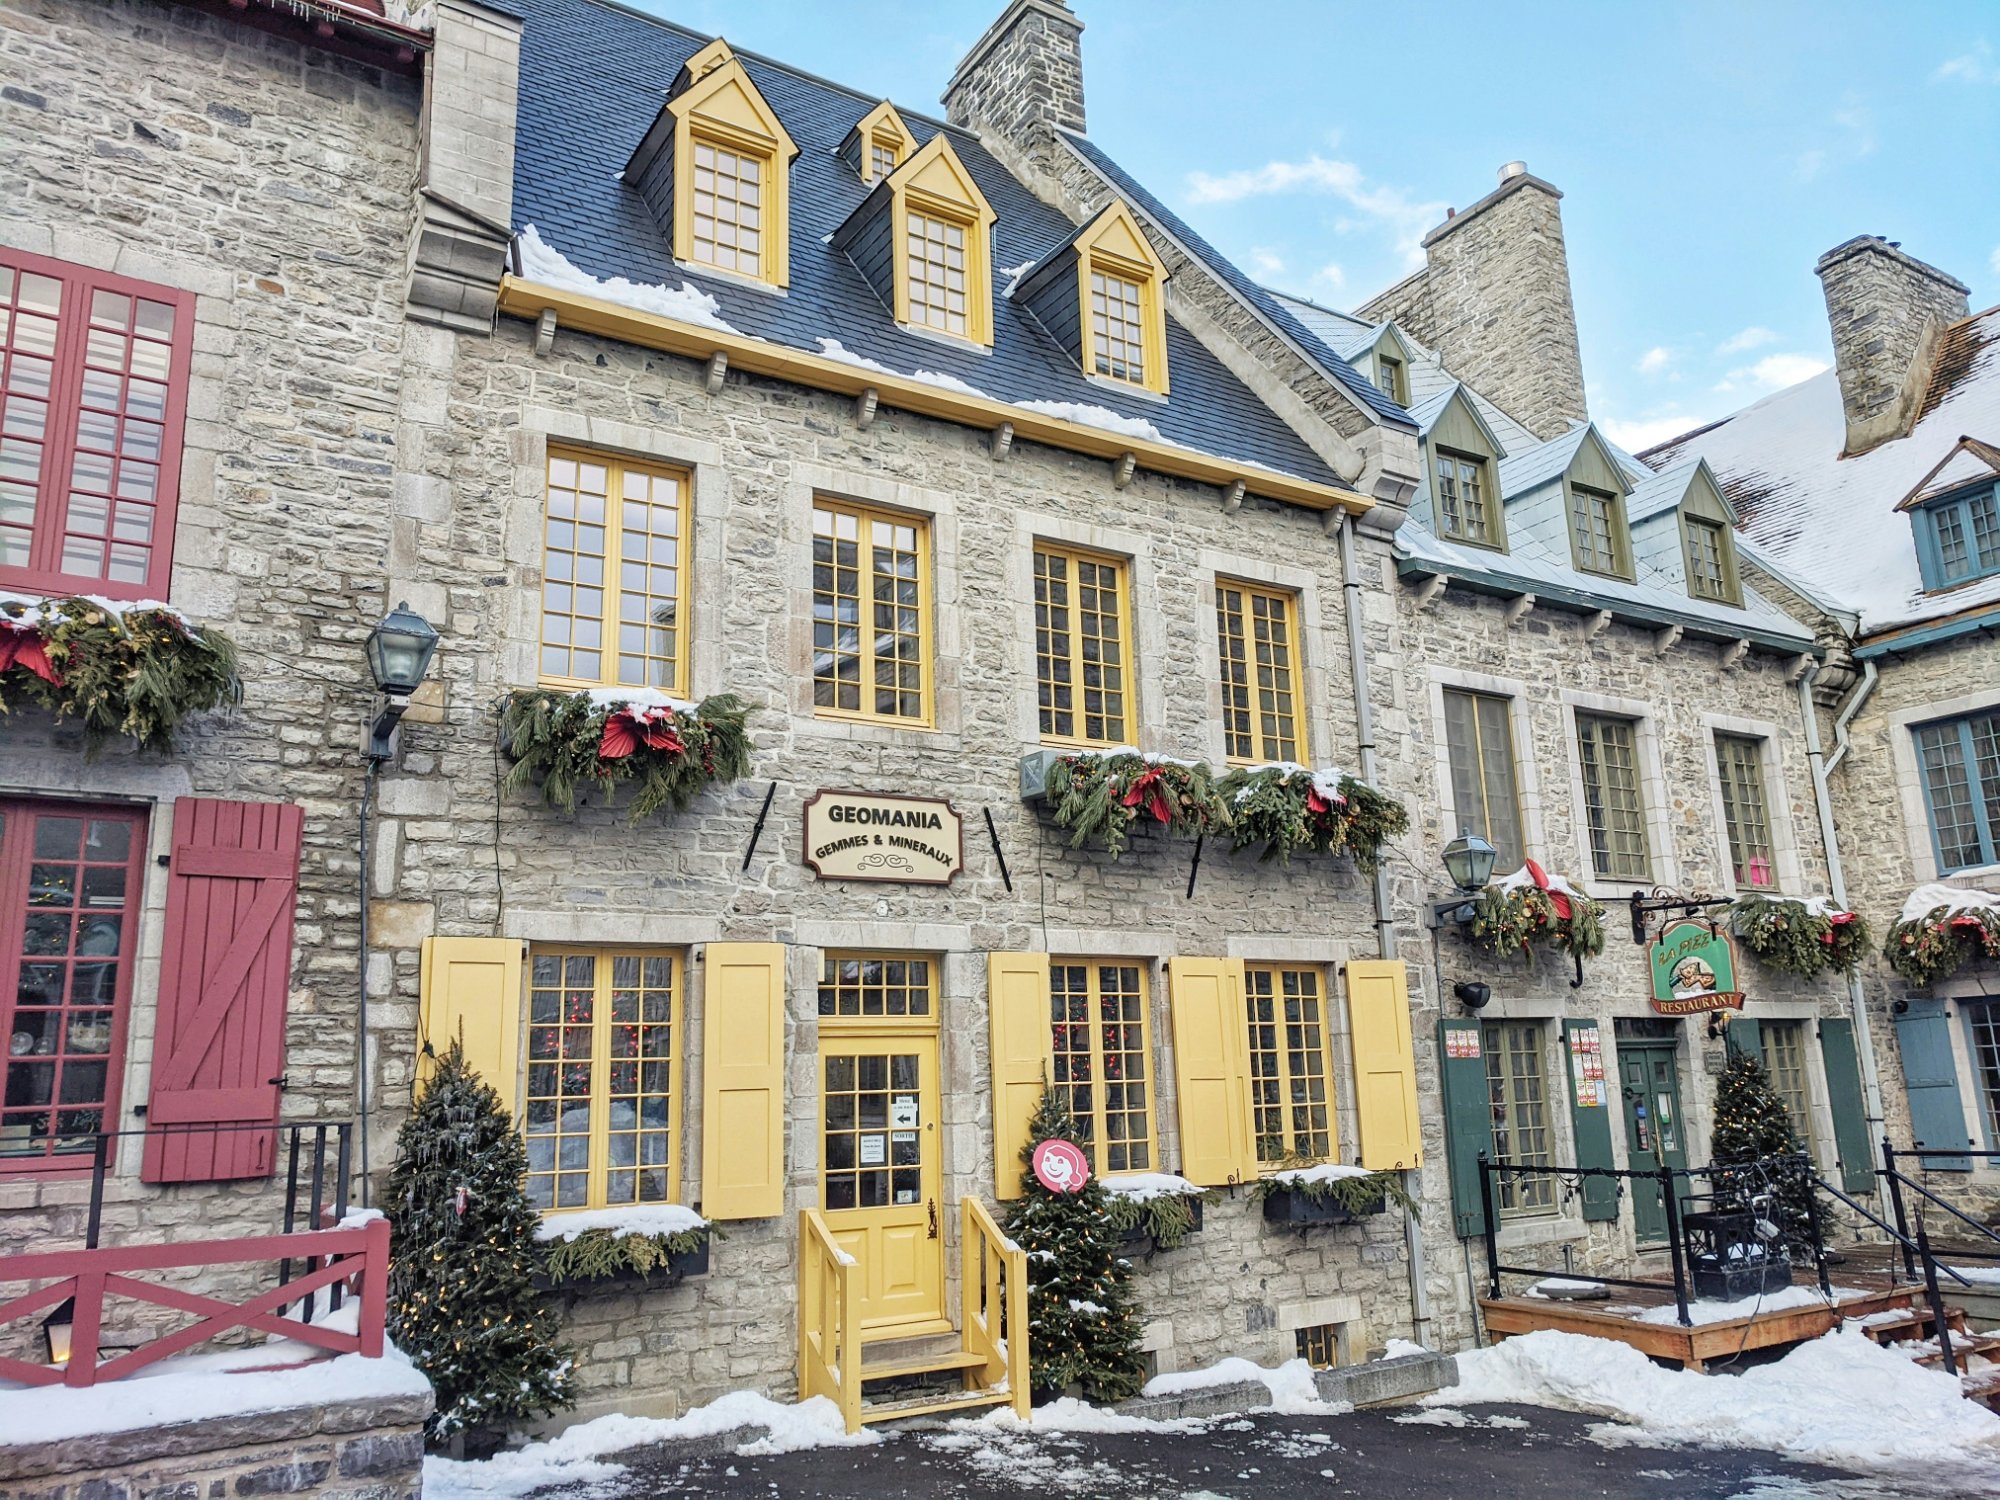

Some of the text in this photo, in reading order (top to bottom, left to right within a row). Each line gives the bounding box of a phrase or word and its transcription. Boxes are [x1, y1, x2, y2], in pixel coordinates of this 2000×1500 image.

[828, 804, 943, 830] GEOMANIA
[815, 834, 954, 868] GEMMES & MINERAUX
[1658, 947, 1676, 967] LA
[1660, 994, 1735, 1013] RESTAURANT
